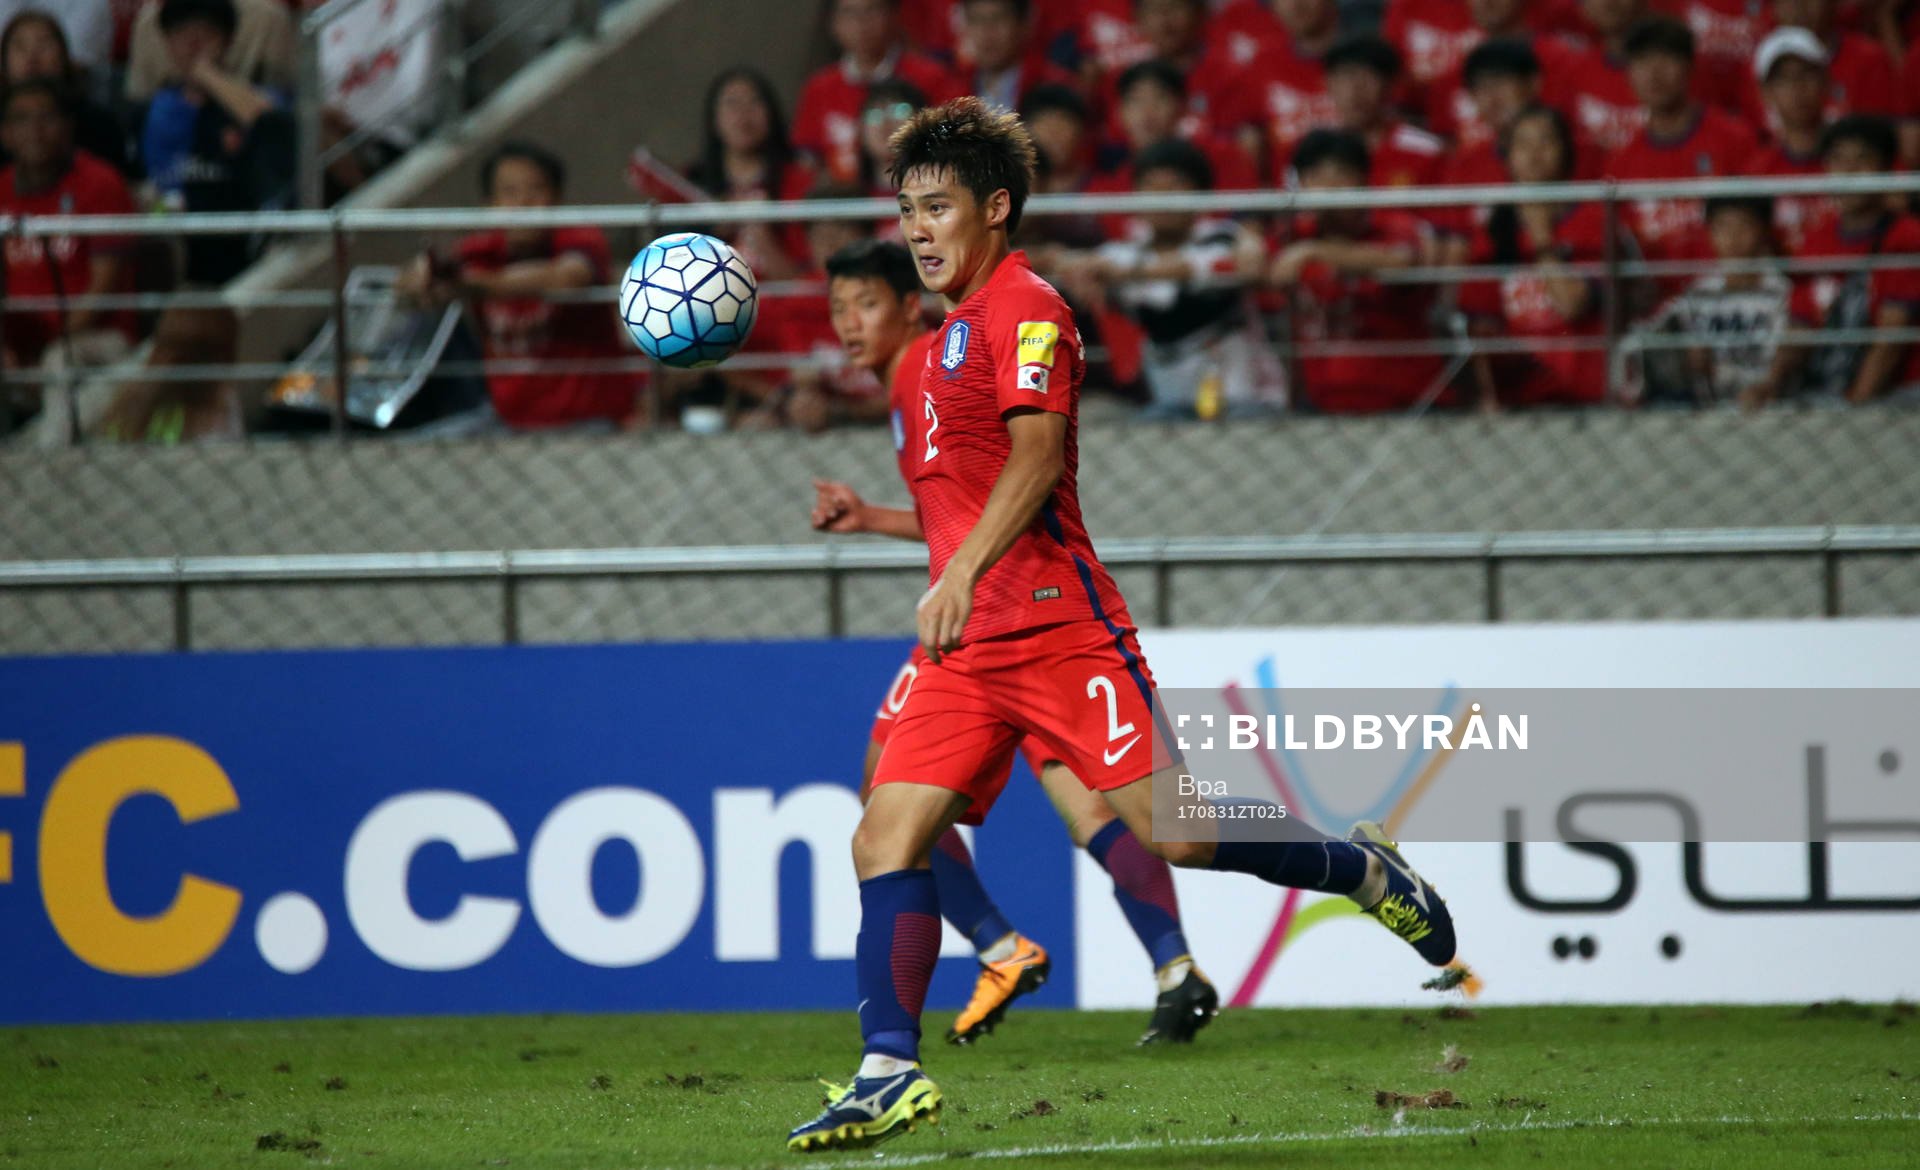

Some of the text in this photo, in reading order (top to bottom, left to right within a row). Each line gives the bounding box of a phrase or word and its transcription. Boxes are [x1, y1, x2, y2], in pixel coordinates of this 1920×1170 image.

[1021, 337, 1044, 346] FIFA
[924, 400, 939, 463] 2
[1086, 675, 1136, 742] 2
[0, 734, 976, 977] C.com
